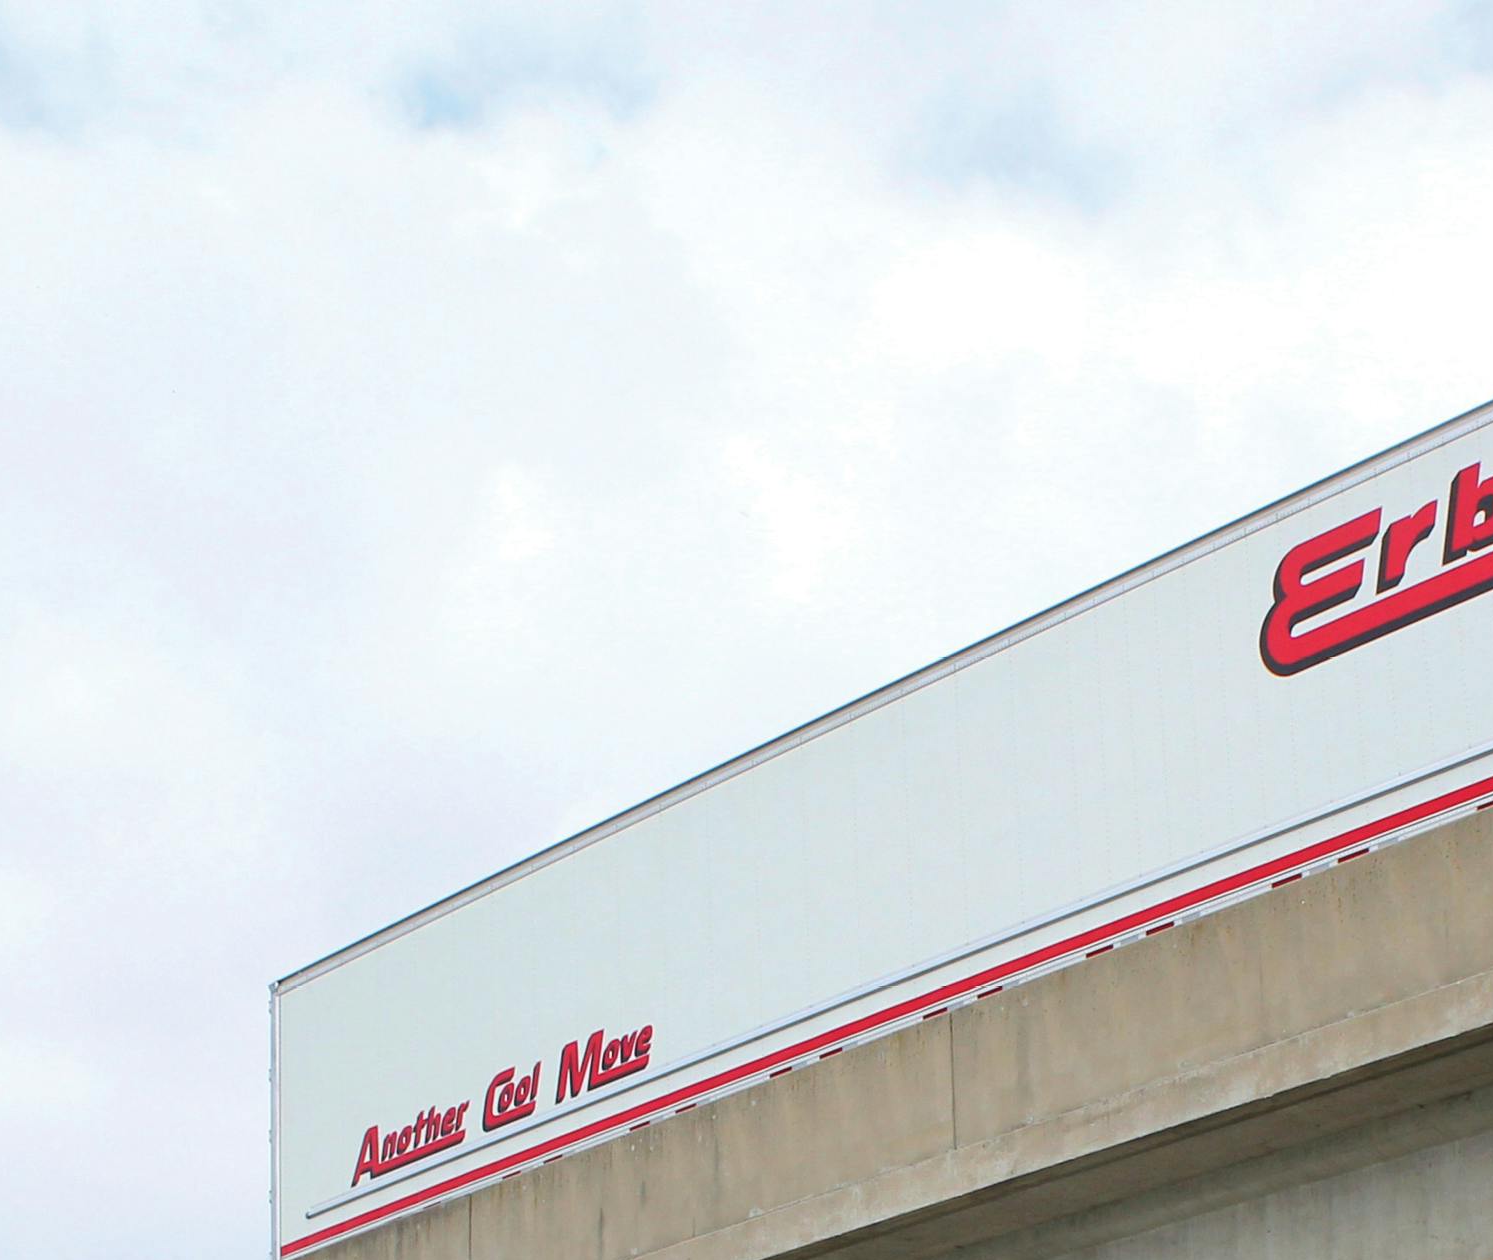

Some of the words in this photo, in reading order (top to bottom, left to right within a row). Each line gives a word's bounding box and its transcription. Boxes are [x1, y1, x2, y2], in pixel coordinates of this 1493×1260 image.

[351, 1100, 470, 1188] Another
[482, 1061, 541, 1132] Cool
[555, 1024, 653, 1105] Move
